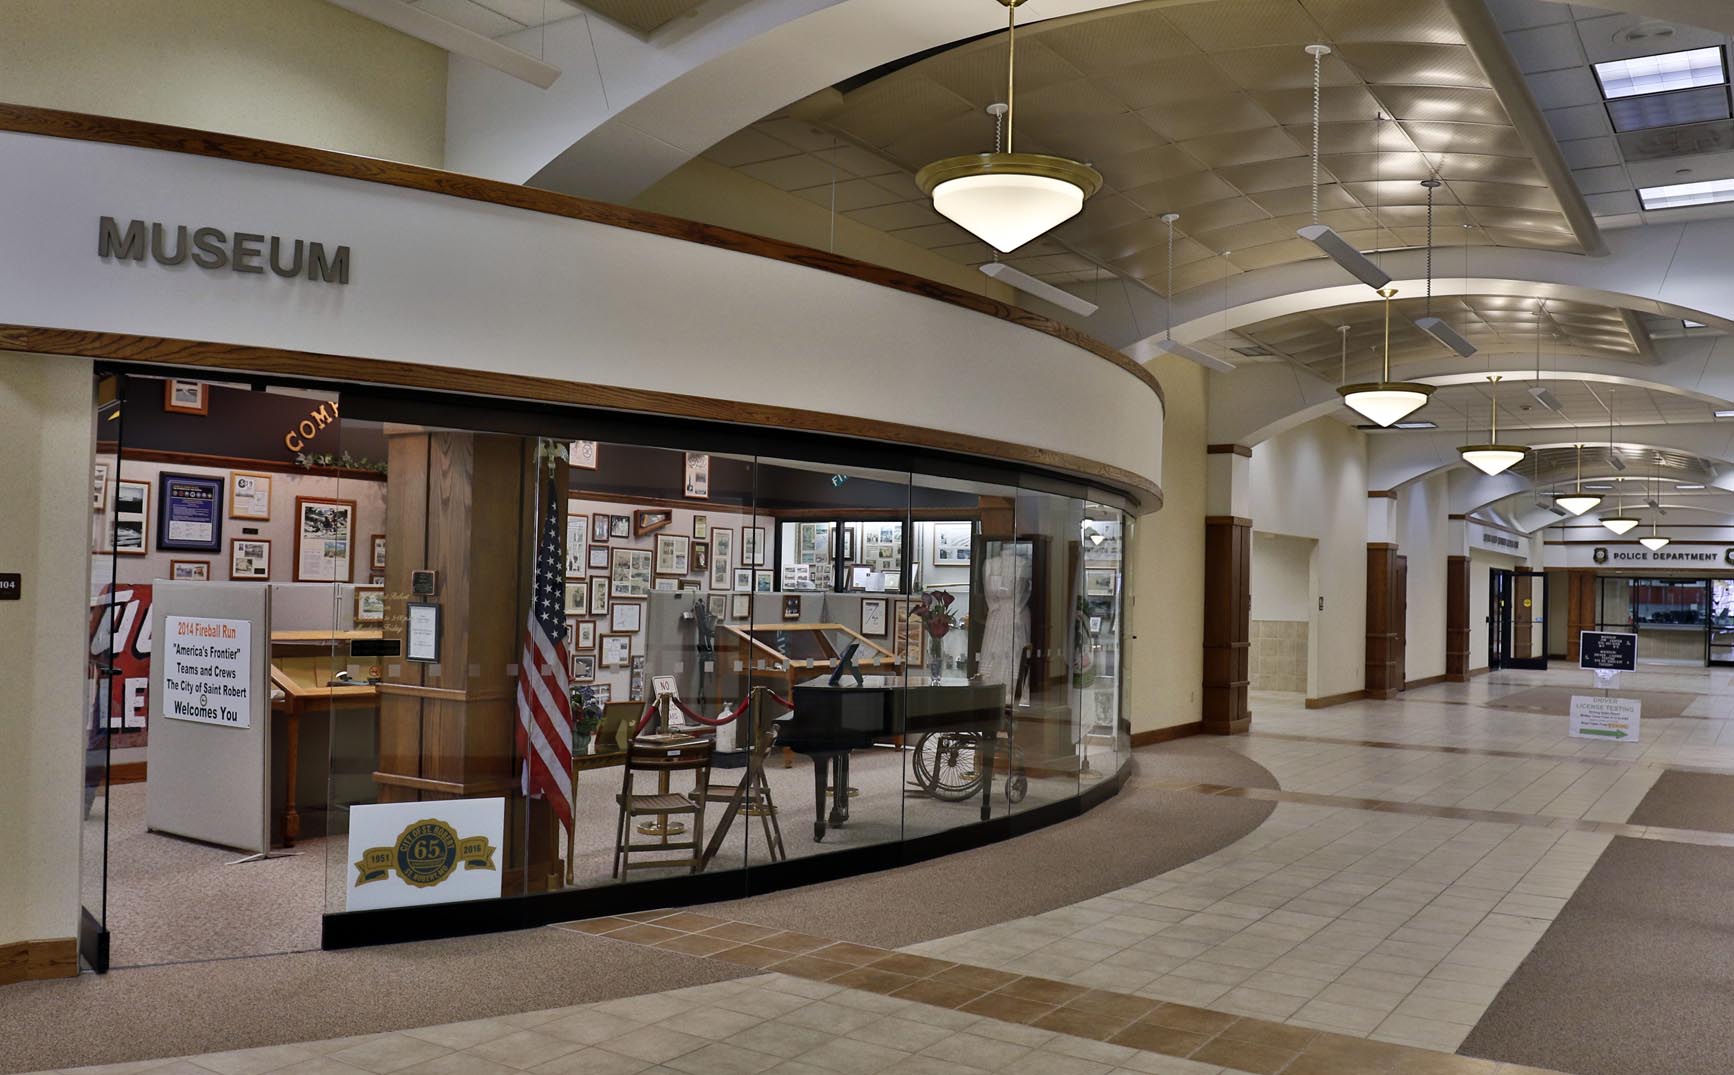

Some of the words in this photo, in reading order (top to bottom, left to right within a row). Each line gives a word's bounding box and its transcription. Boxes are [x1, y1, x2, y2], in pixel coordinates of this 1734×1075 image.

[98, 216, 351, 284] MUSEUM
[1613, 552, 1648, 560] POLICE
[1653, 552, 1718, 561] DEPARTMENT
[178, 621, 194, 636] 2014
[195, 623, 220, 638] Fireball
[223, 625, 236, 639] Run
[173, 643, 208, 657] "America's
[210, 646, 240, 660] Frontier"
[177, 662, 198, 675] Teams
[200, 665, 212, 677] and
[214, 666, 236, 679] Crews
[166, 678, 179, 690] The
[180, 680, 193, 695] City
[195, 682, 202, 693] of
[203, 683, 221, 695] Saint
[223, 685, 247, 698] Robert
[660, 681, 670, 690] NO
[174, 700, 217, 719] Welcomes
[220, 706, 237, 722] You
[414, 840, 440, 860] 65
[371, 853, 390, 865] 1951
